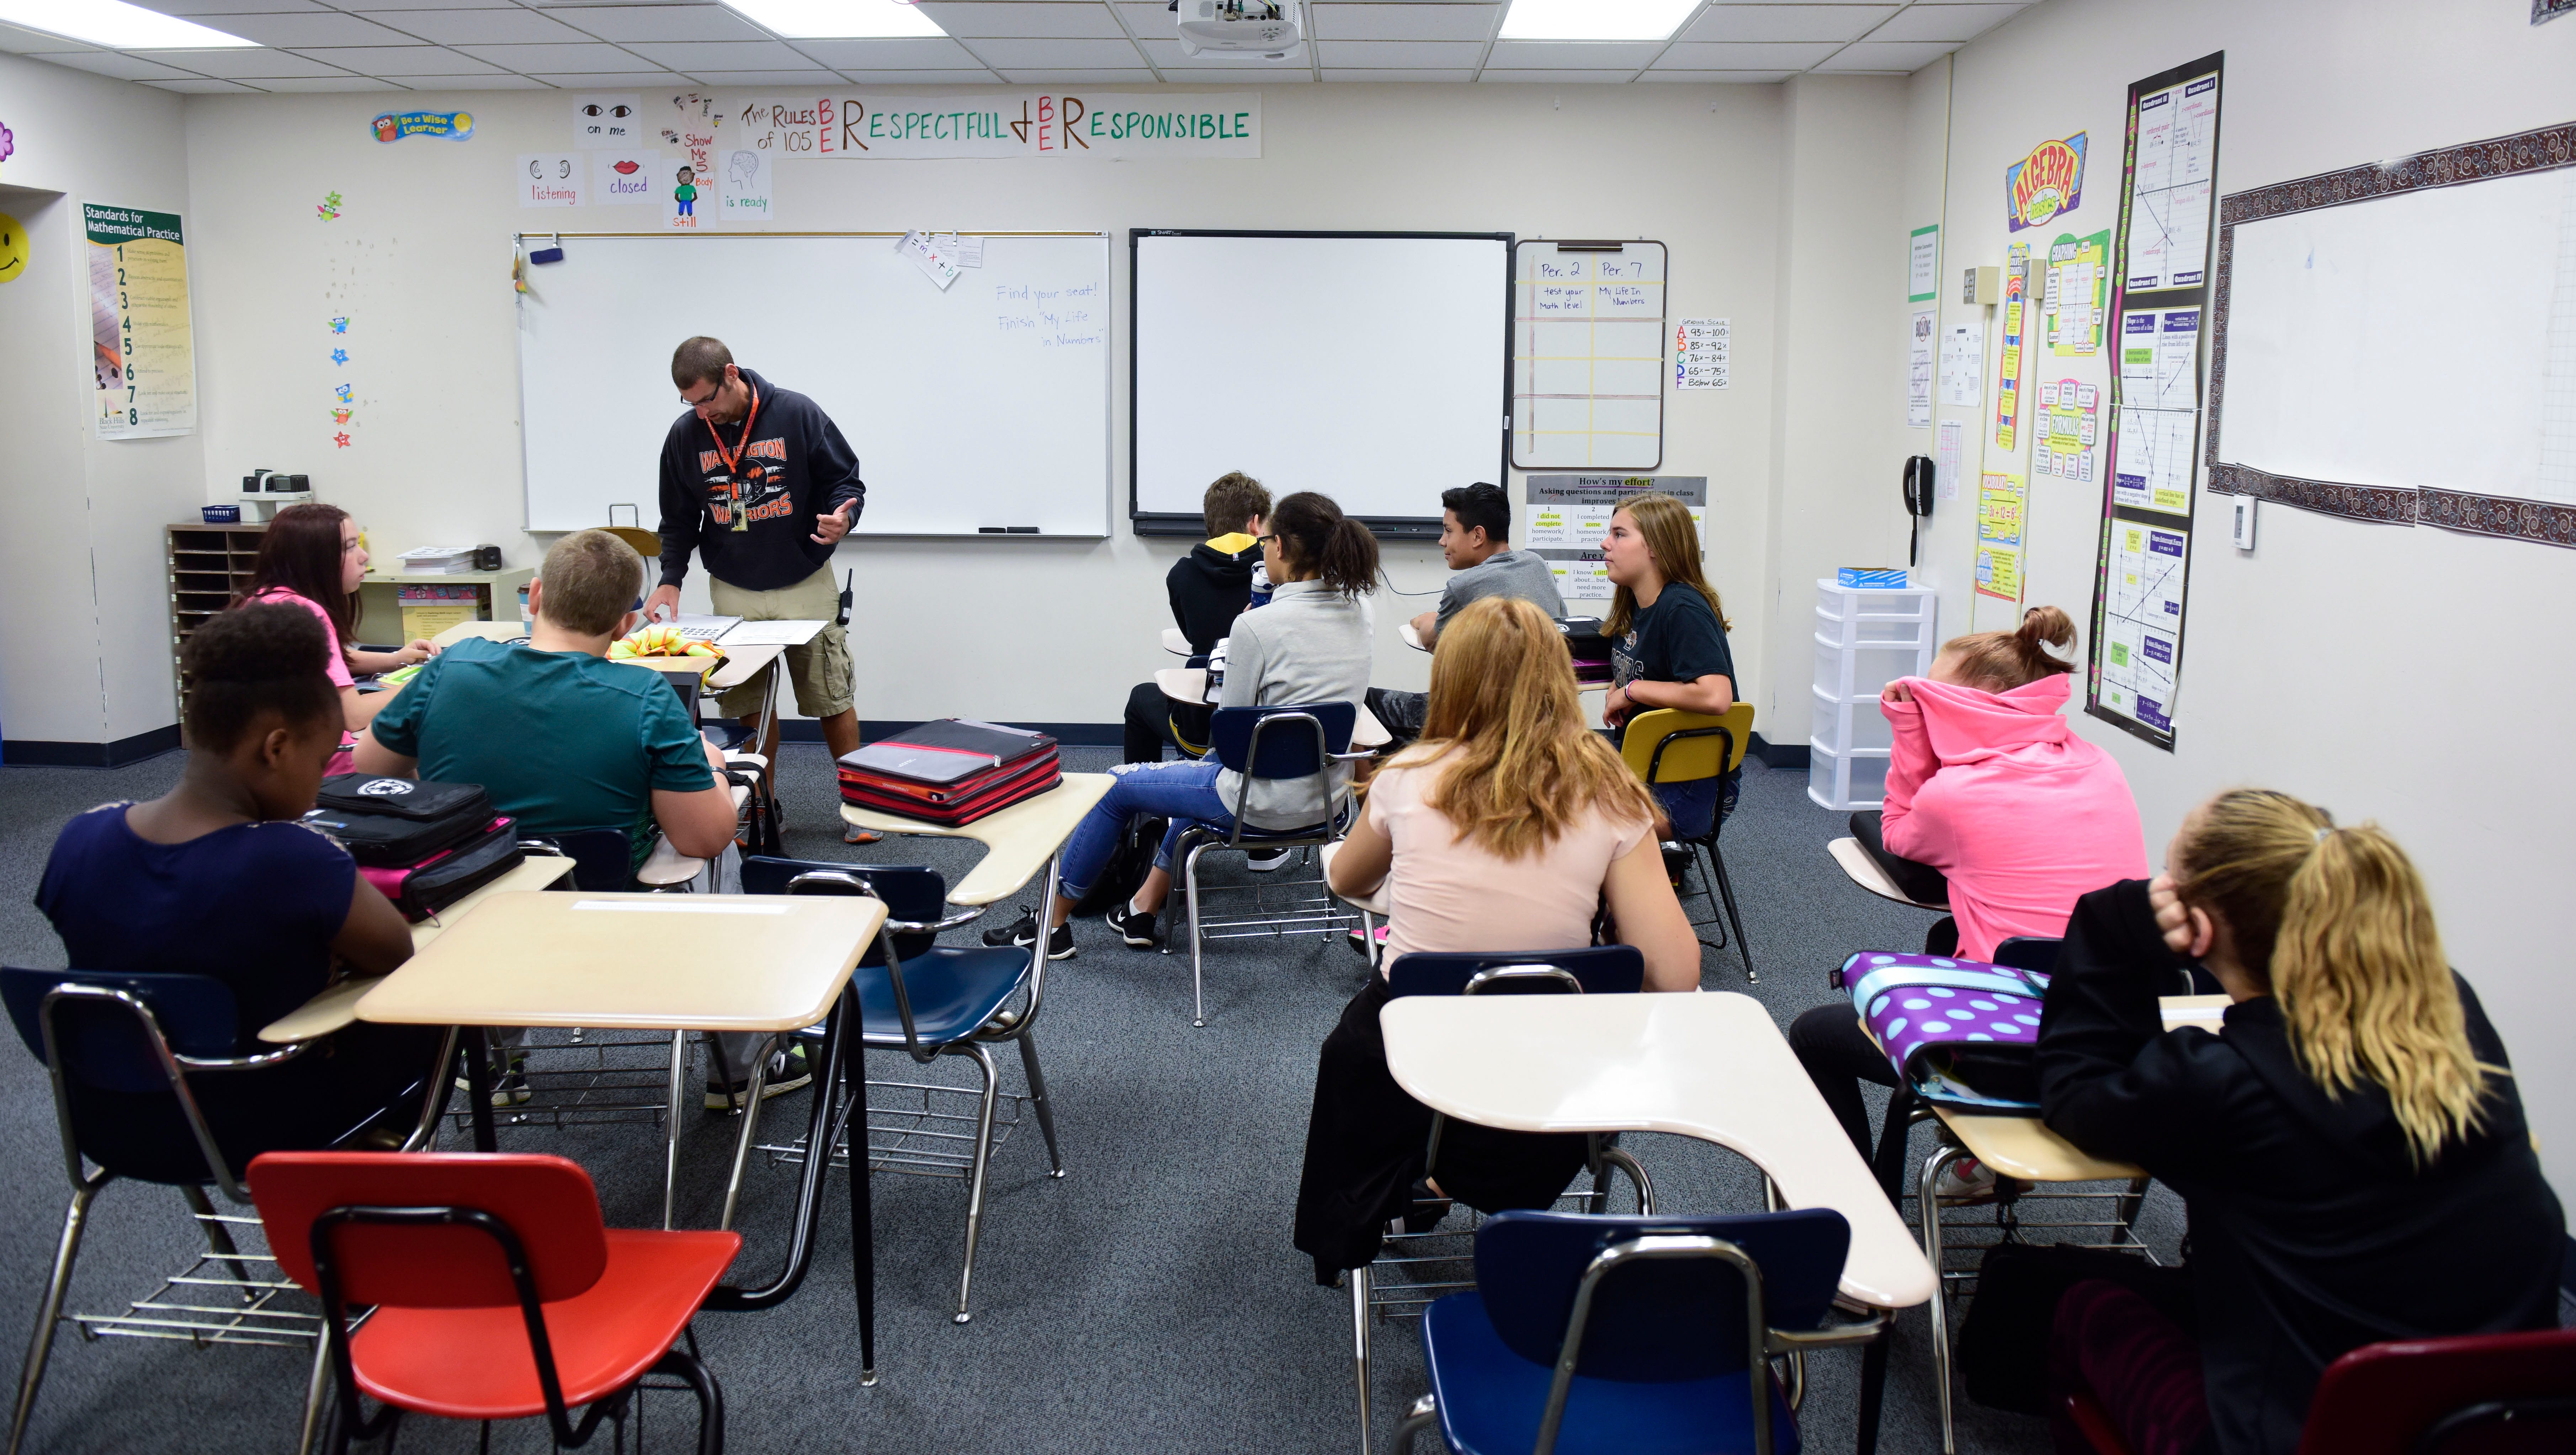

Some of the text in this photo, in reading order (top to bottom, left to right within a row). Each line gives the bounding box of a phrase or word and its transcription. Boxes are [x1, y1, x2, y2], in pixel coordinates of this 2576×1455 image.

[2188, 82, 2209, 94] Quadrant
[2142, 97, 2161, 109] Quadrant
[423, 114, 447, 124] Wise
[741, 103, 816, 128] The RULES
[403, 125, 447, 135] Learner
[843, 100, 1008, 150] RESPECTFUL
[1063, 97, 1249, 149] RESPONSIBLE
[2146, 124, 2169, 135] ordered pair
[609, 127, 626, 135] me
[685, 134, 712, 146] Show
[758, 131, 812, 151] of 105
[691, 149, 706, 161] Me
[696, 161, 708, 172] 5
[610, 176, 647, 193] closed
[696, 178, 713, 190] Body
[2016, 146, 2074, 216] ALGEBRA
[533, 185, 575, 205] listening
[726, 196, 767, 212] is ready
[2030, 194, 2056, 220] basics
[86, 206, 143, 223] Standards for
[673, 217, 696, 227] Still
[88, 220, 180, 240] Mathematical Practice
[117, 245, 123, 262] 1
[2022, 247, 2026, 256] TO
[2052, 242, 2077, 262] GRAPHING
[2010, 257, 2020, 266] SOLVE
[1542, 262, 1579, 277] Per. 2
[1602, 262, 1642, 277] Per. 7
[118, 268, 126, 286] 2
[2130, 278, 2150, 287] Quadrant
[2174, 273, 2196, 283] Quadrant
[996, 282, 1097, 308] Find your seat!
[1544, 287, 1583, 301] test your
[1599, 287, 1611, 299] My
[121, 292, 128, 309] 3
[1565, 300, 1582, 309] level
[123, 315, 131, 333] 4
[998, 311, 1088, 330] Finish "My Life
[1677, 326, 1686, 338] A
[124, 338, 132, 355] 5
[1042, 337, 1051, 346] in
[1678, 338, 1687, 351] B
[1677, 351, 1685, 364] C
[126, 363, 134, 380] 6
[1677, 364, 1685, 377] D
[1677, 376, 1685, 389] F
[1689, 379, 1710, 387] Below
[127, 386, 136, 403] 7
[129, 408, 138, 425] 8
[2051, 415, 2080, 436] FORMULAS
[1579, 477, 1606, 485] How's
[1625, 478, 1655, 486] effort?
[1982, 474, 2007, 491] VOCABULARY
[708, 491, 793, 524] WARIORS
[1989, 505, 2006, 519] 3x 12
